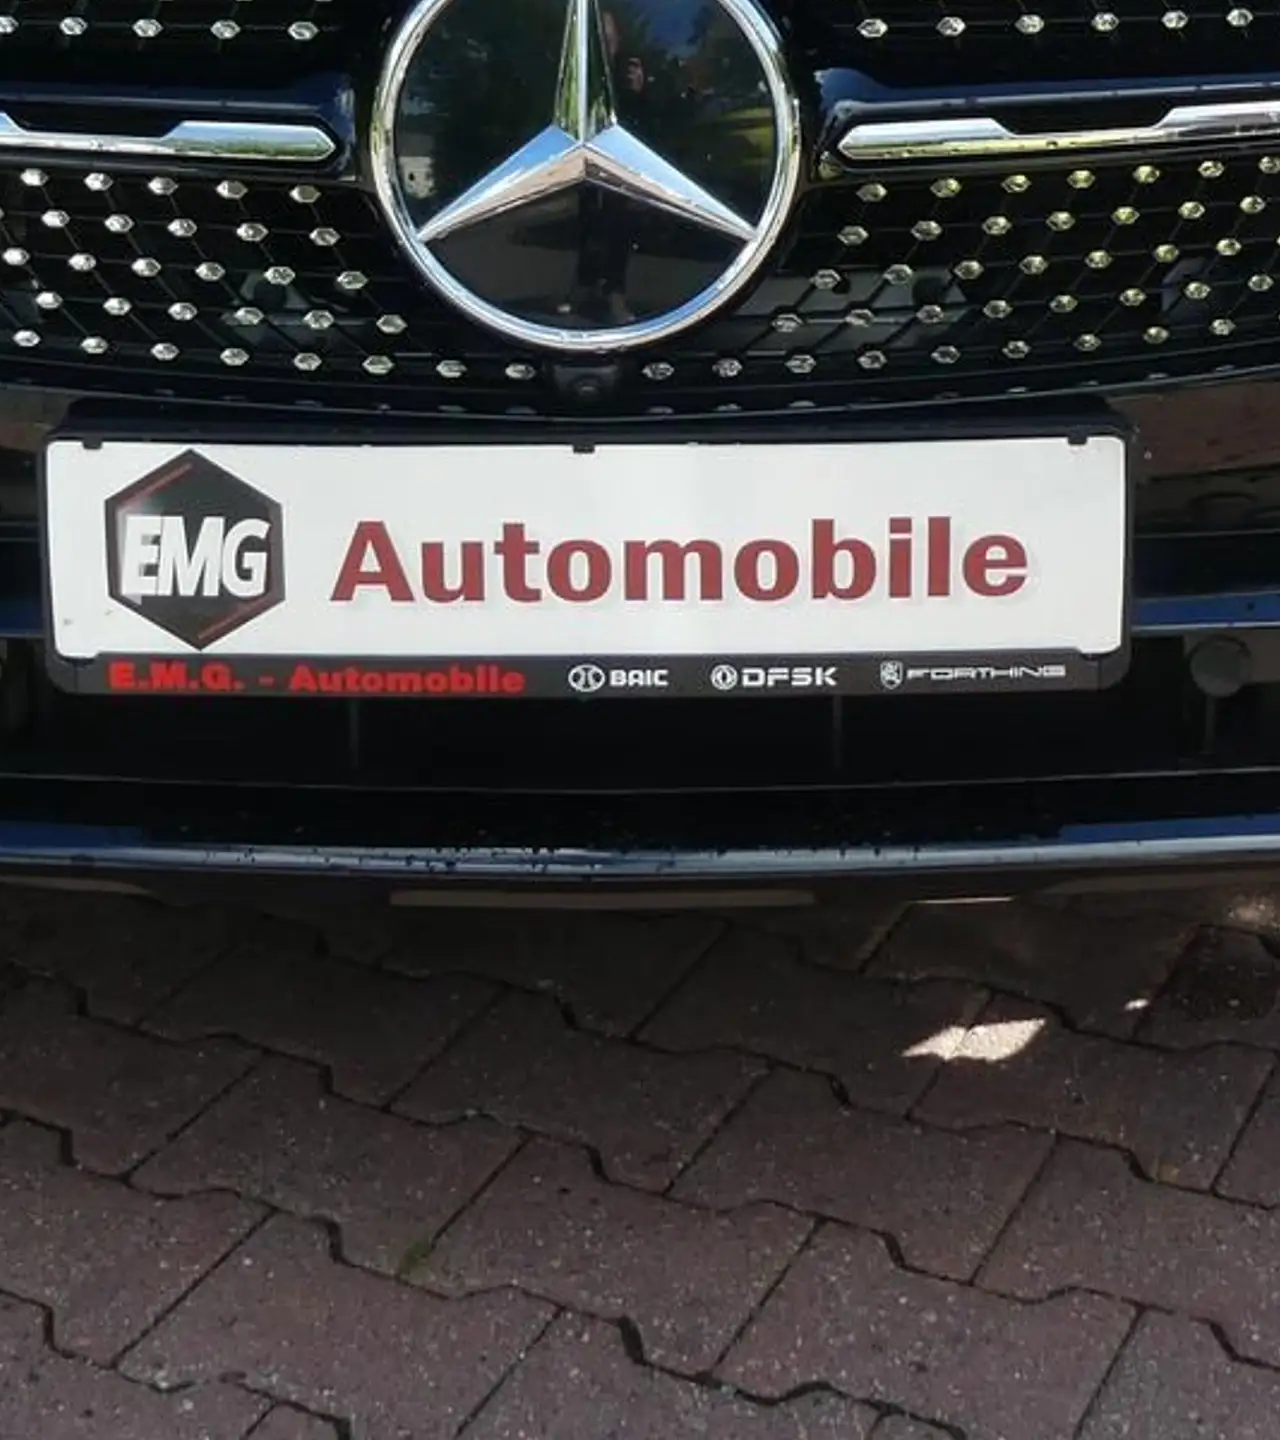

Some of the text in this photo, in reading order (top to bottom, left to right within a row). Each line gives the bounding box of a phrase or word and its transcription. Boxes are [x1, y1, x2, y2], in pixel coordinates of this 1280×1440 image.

[121, 514, 1028, 603] EMG Automobile
[107, 664, 245, 691] E.M.G.
[289, 664, 526, 694] Automobile
[610, 669, 668, 687] BAIC
[741, 666, 838, 688] DFSK
[905, 663, 1067, 680] FORTHING
